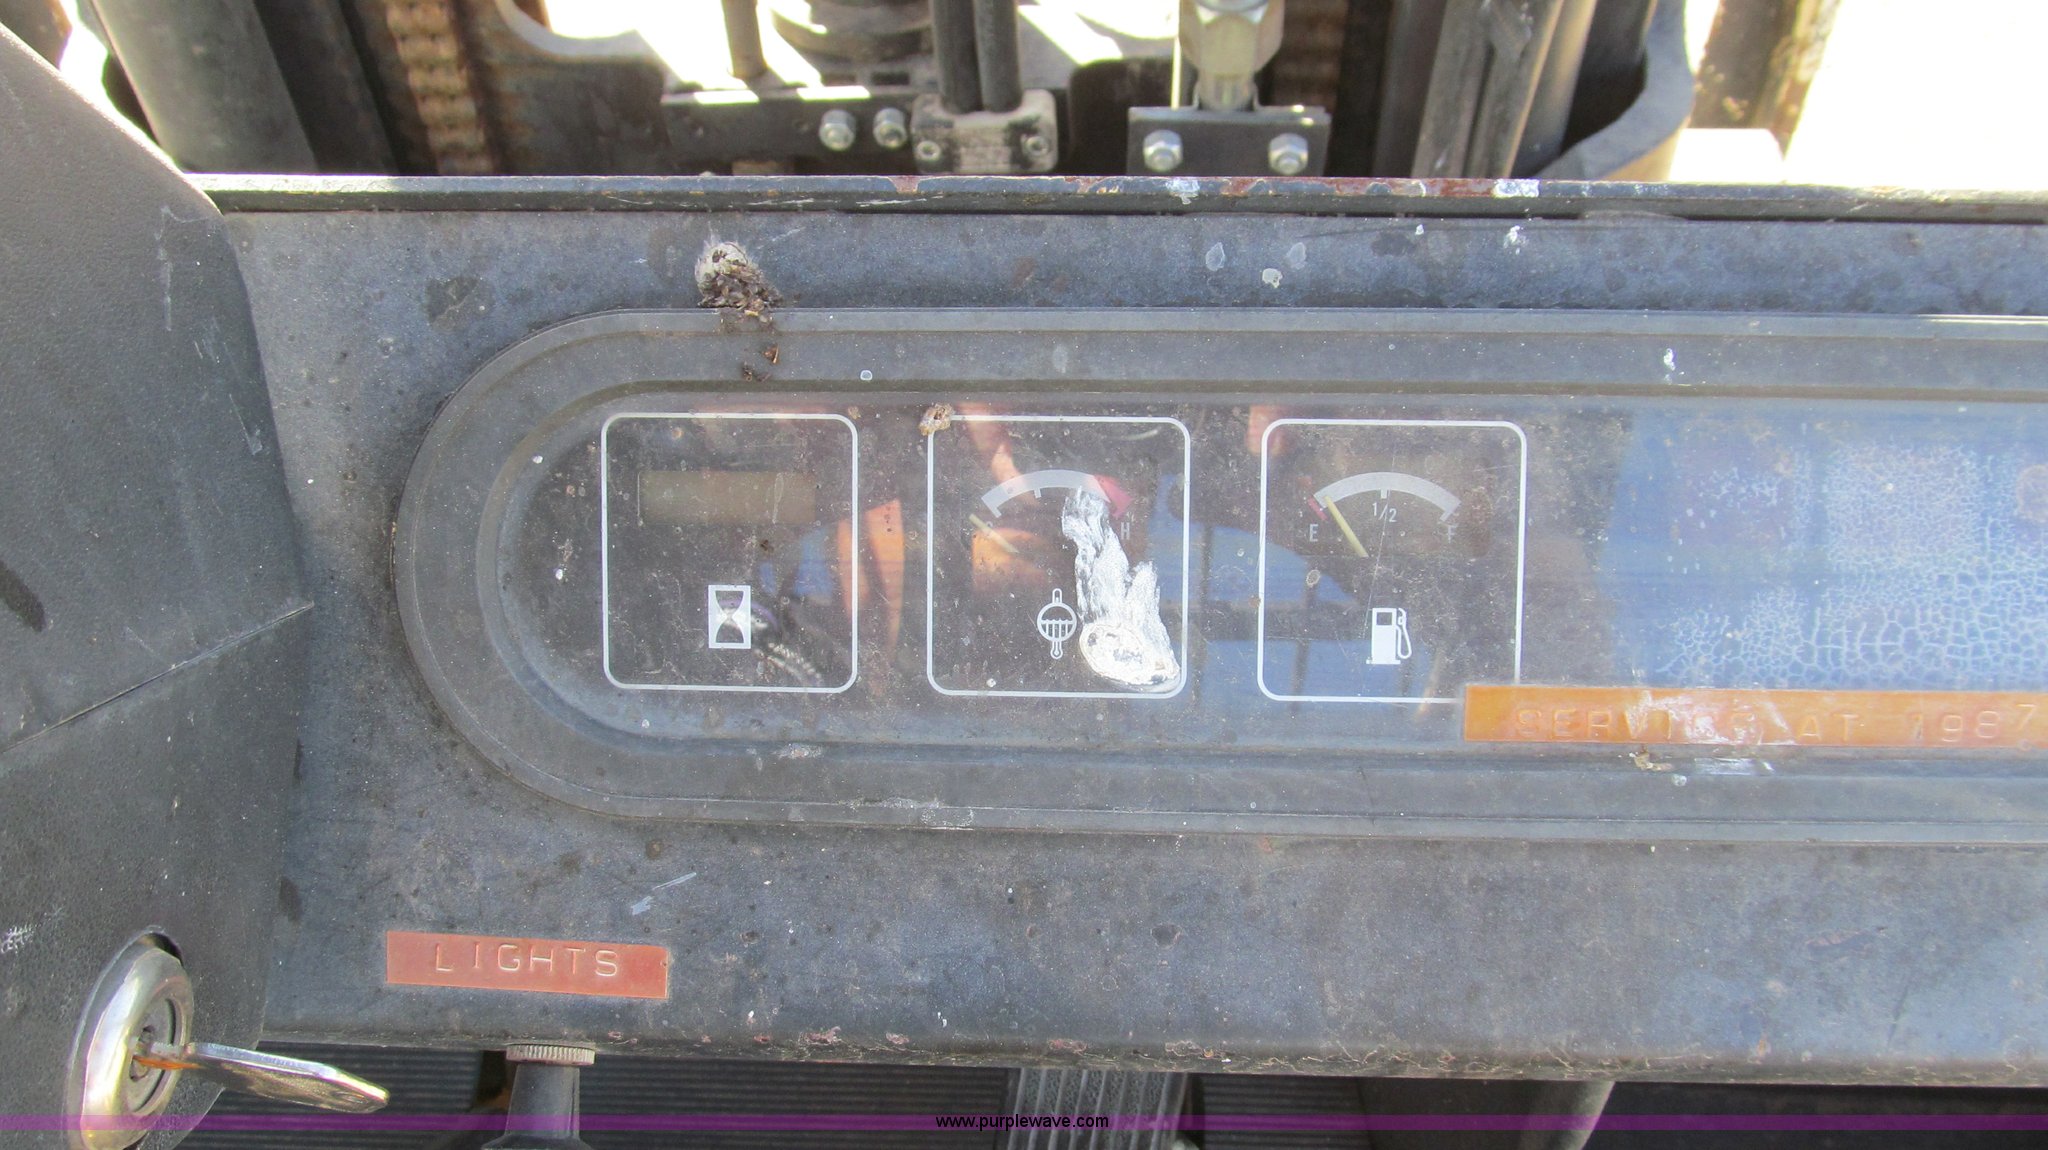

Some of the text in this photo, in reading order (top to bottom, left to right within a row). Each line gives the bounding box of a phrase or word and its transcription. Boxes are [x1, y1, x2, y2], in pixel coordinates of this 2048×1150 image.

[1372, 501, 1397, 523] 1/2
[1120, 522, 1131, 540] H
[1309, 523, 1319, 542] E
[1799, 713, 1860, 742] AT
[435, 941, 619, 977] LIGHTS
